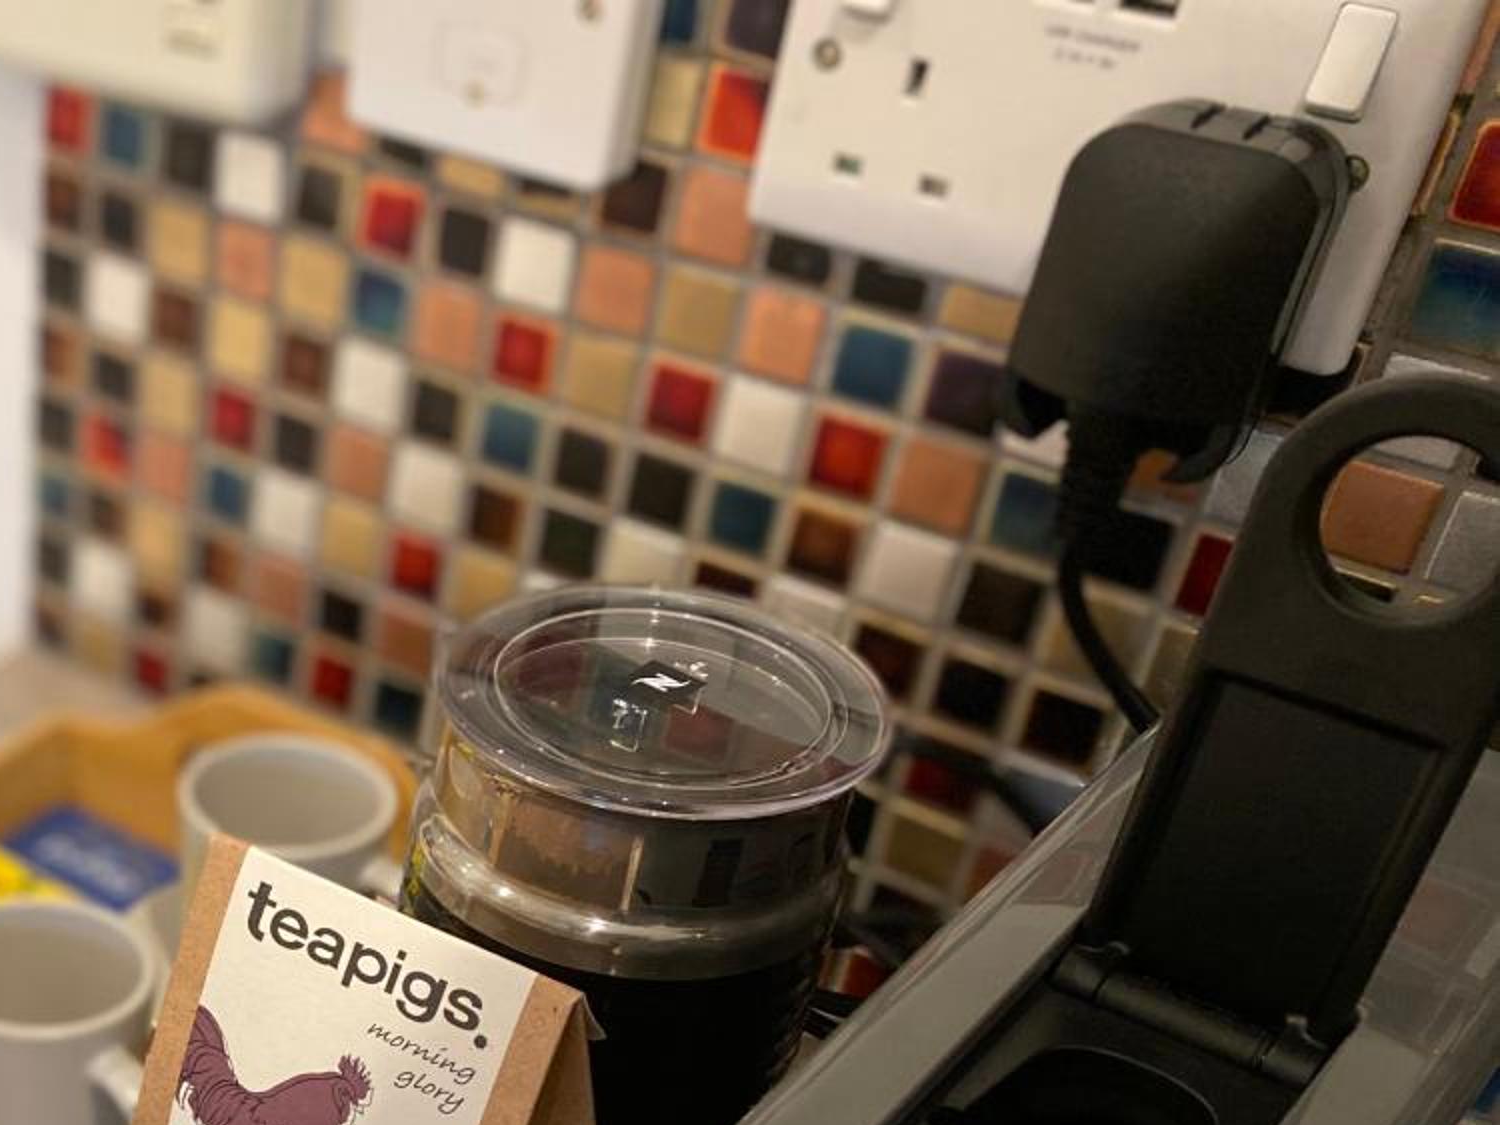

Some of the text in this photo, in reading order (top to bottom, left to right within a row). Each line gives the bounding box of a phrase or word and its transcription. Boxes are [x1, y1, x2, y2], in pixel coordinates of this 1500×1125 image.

[248, 881, 488, 1049] teapigs.
[367, 1023, 476, 1085] morning
[393, 1071, 464, 1115] glory
